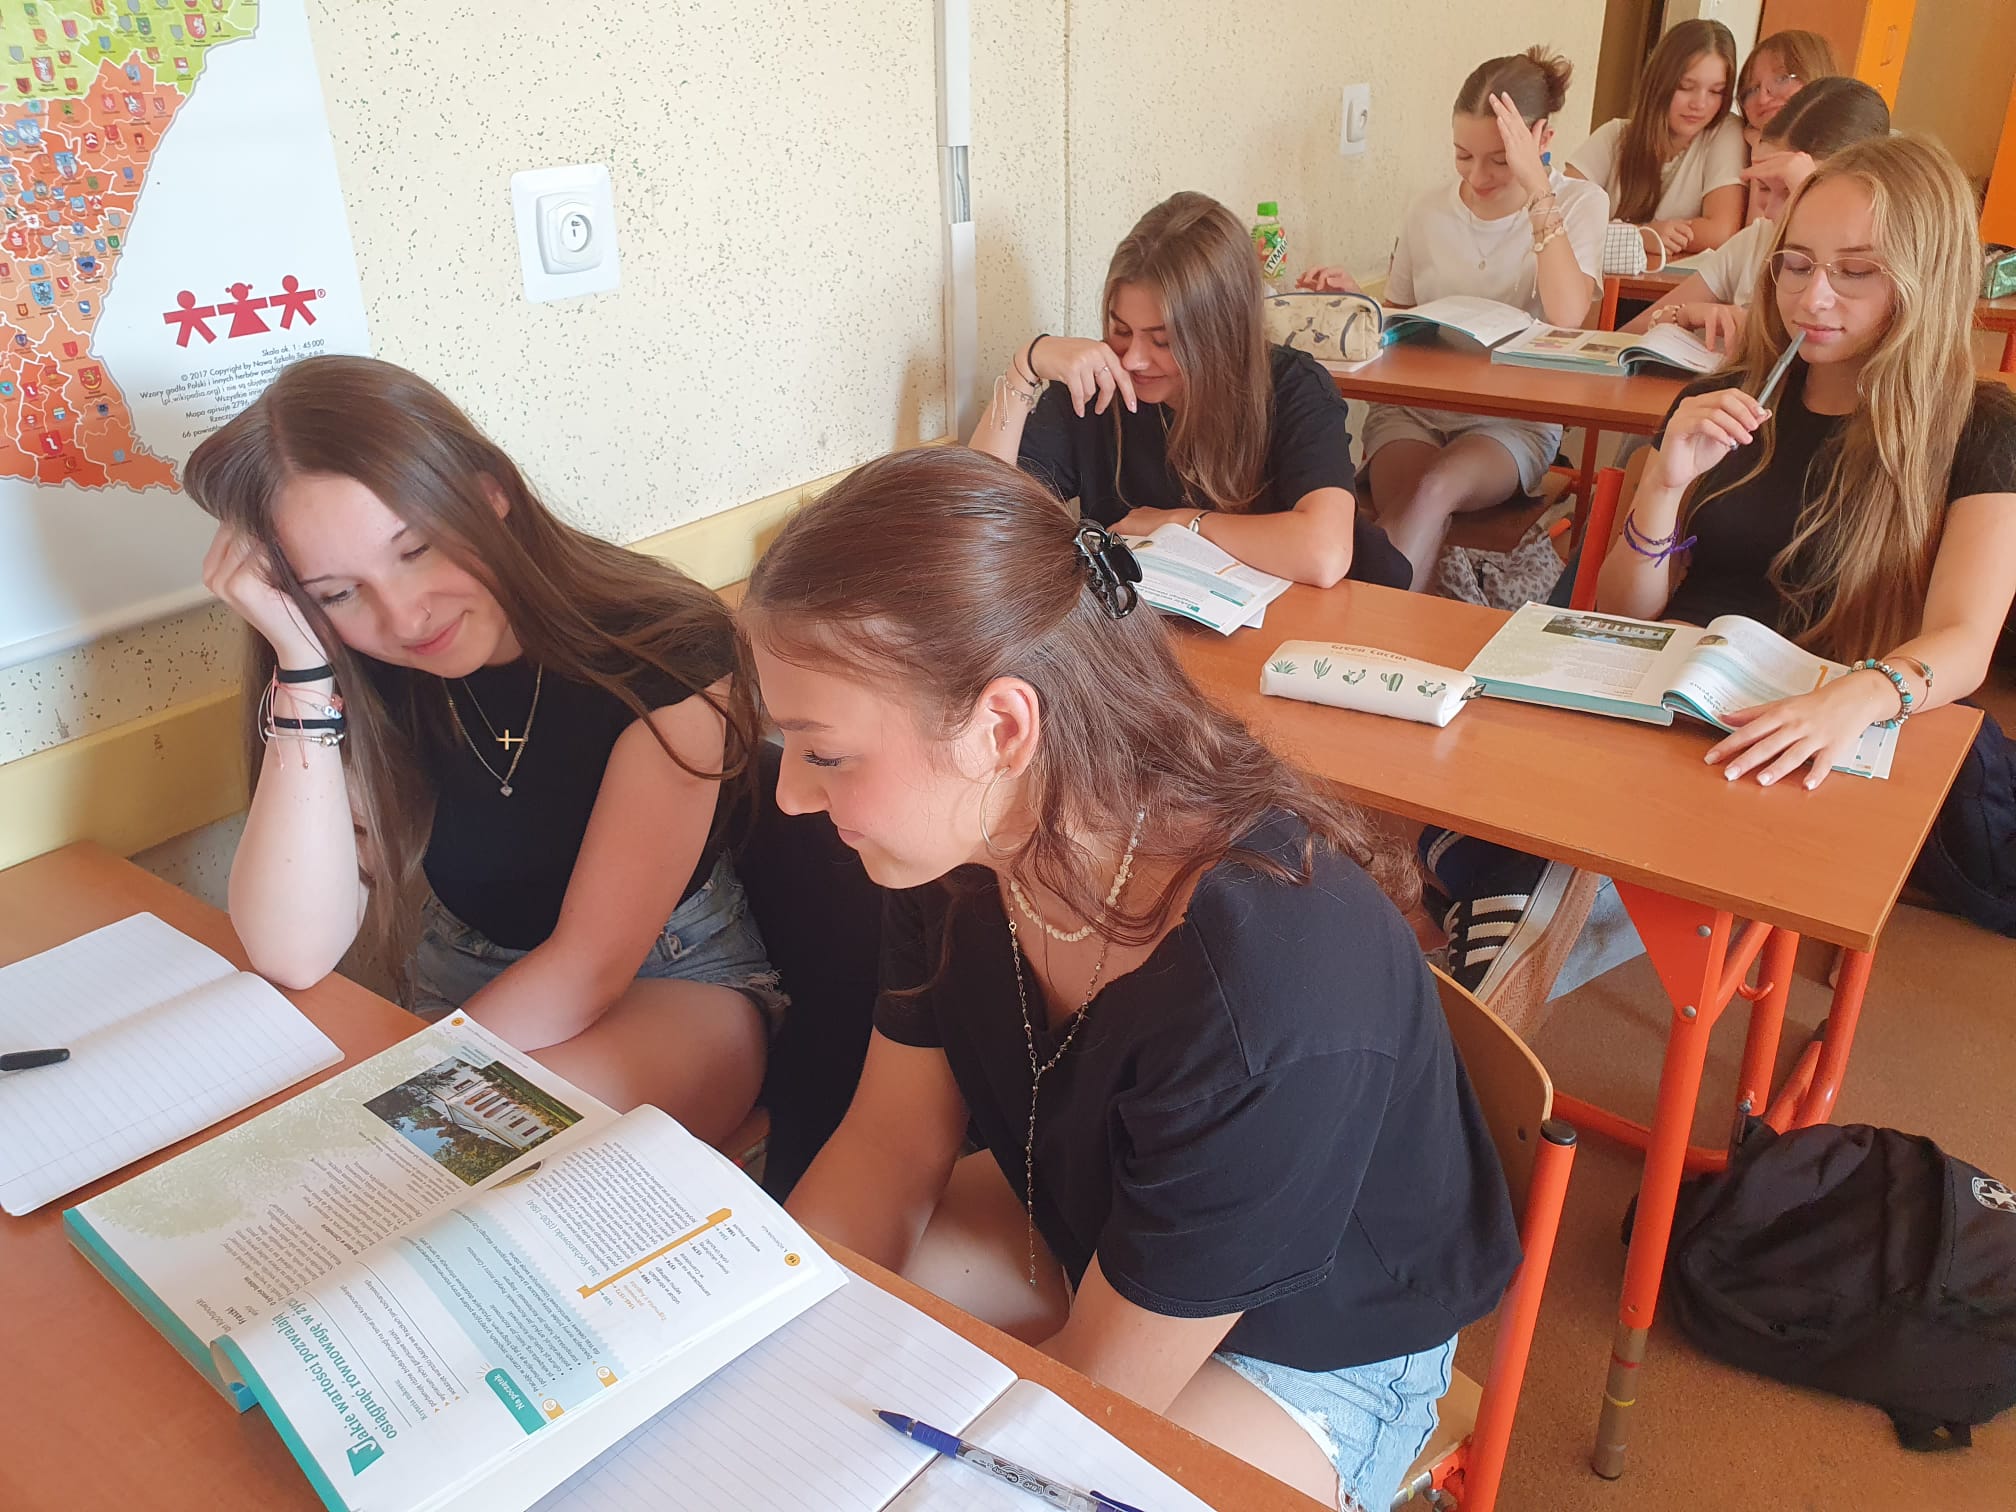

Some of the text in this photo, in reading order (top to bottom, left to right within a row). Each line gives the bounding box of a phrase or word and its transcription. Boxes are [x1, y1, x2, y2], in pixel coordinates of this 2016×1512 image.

[140, 390, 163, 400] Wzory
[187, 380, 206, 389] Polski
[212, 375, 233, 385] innych
[235, 370, 259, 380] herbów
[190, 370, 207, 380] 2017
[210, 364, 242, 376] Copyright
[243, 362, 252, 371] by
[185, 409, 205, 419] Mapa
[299, 1312, 314, 1326] w
[305, 1320, 363, 1392] równowagę
[269, 1311, 378, 1459] Jakie wartości pozwalają
[492, 1371, 525, 1410] Na początek
[351, 1384, 401, 1443] osiągnąć
